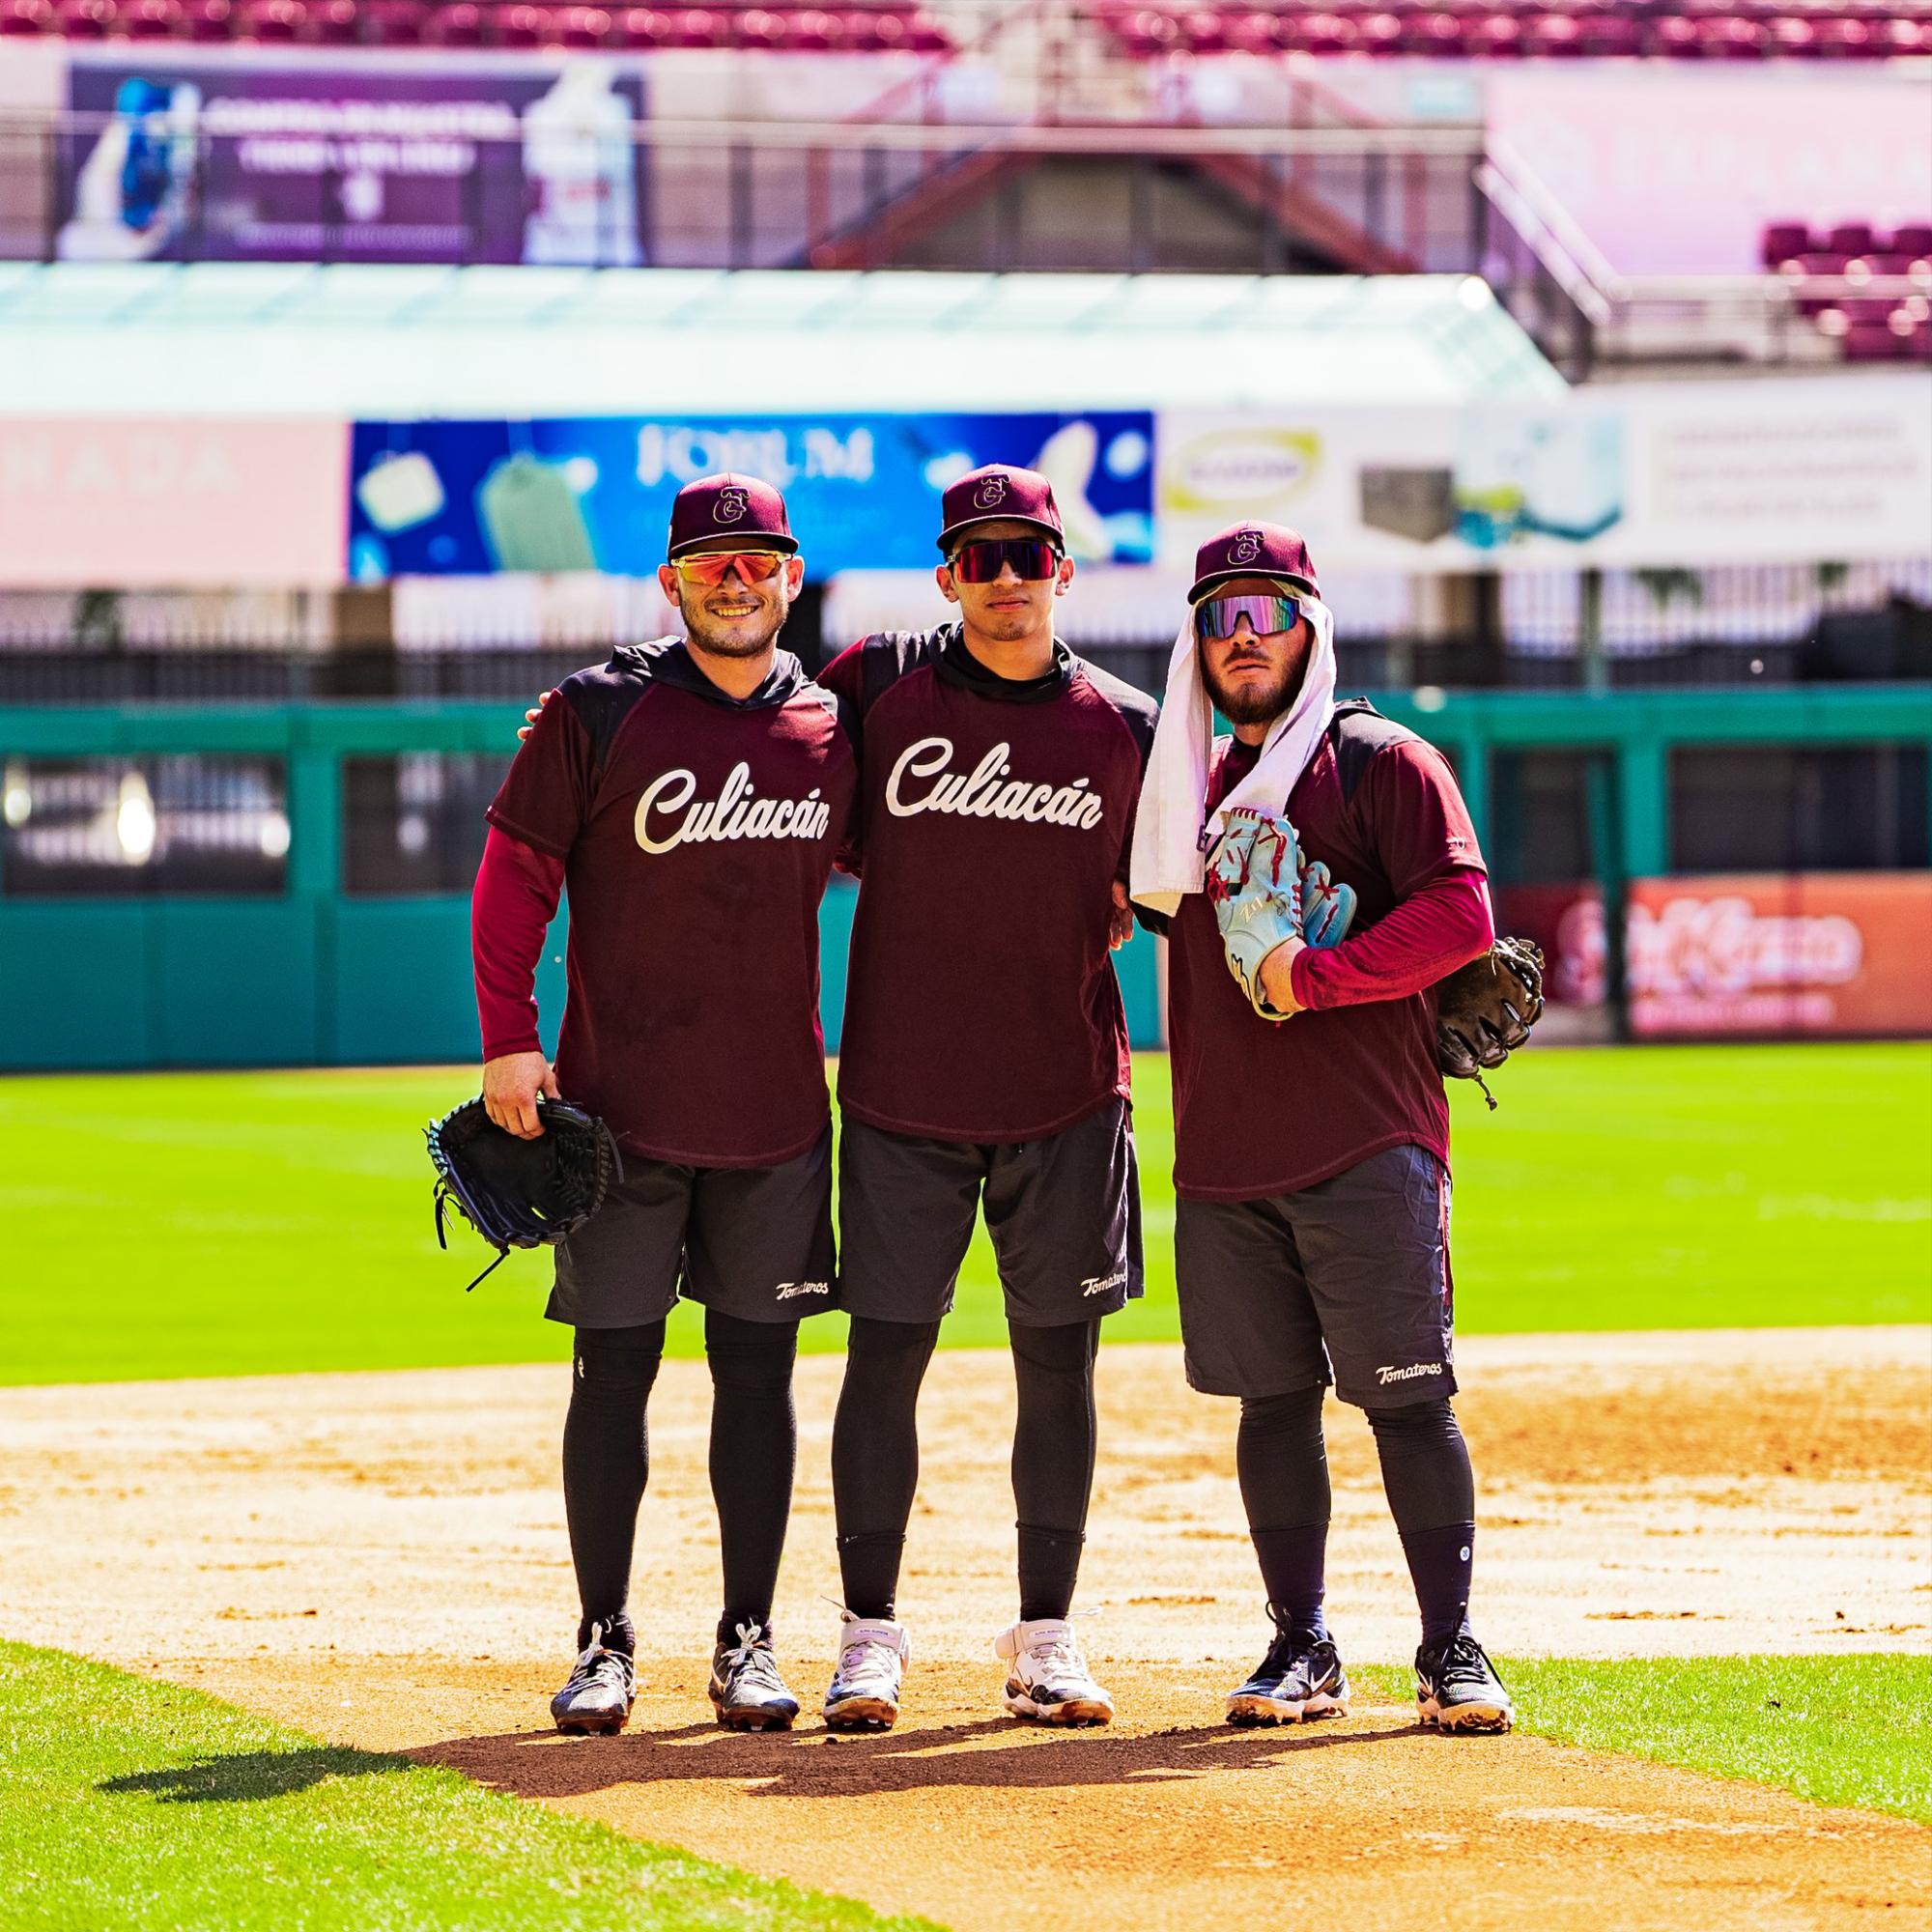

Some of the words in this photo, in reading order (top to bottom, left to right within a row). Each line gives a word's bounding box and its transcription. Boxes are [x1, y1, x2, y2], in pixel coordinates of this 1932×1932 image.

[634, 761, 831, 854] Culiacán
[886, 737, 1103, 830] Culiacán
[1376, 1362, 1442, 1385] Tomateros
